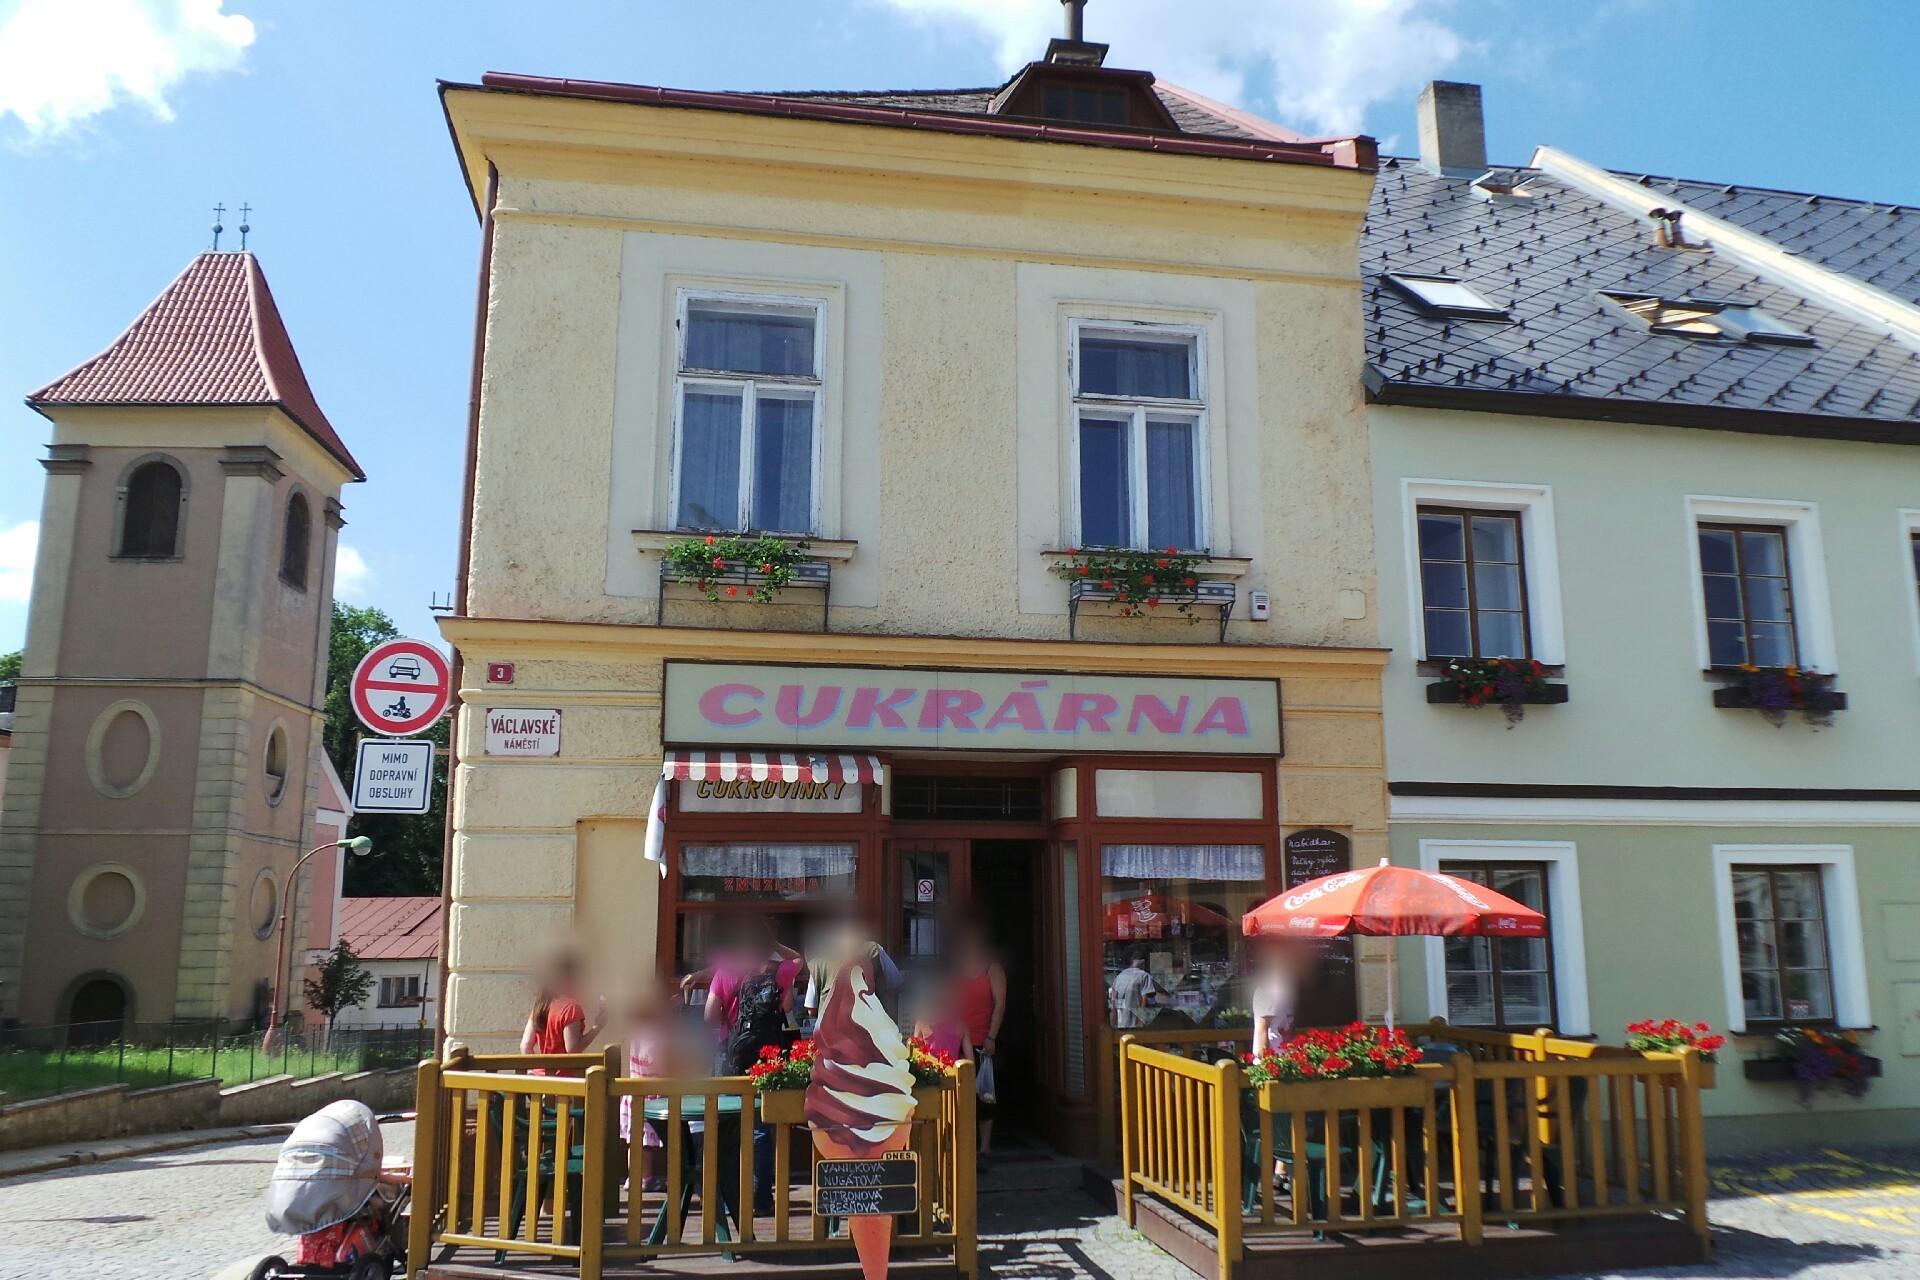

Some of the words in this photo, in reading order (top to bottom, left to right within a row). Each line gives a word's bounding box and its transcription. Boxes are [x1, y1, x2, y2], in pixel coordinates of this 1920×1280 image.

[496, 668, 504, 679] 3
[697, 679, 1252, 738] CUKRÁRNA
[490, 714, 556, 735] VÁCLAVSKÉ
[503, 737, 541, 750] NÁMĚSTÍ
[381, 752, 409, 764] MIMO
[369, 767, 418, 781] DOPRAVNÍ
[369, 786, 414, 799] OBSLUHY
[824, 1174, 882, 1187] NUGÁTOVÁ
[822, 1188, 883, 1201] CITRONOVÁ
